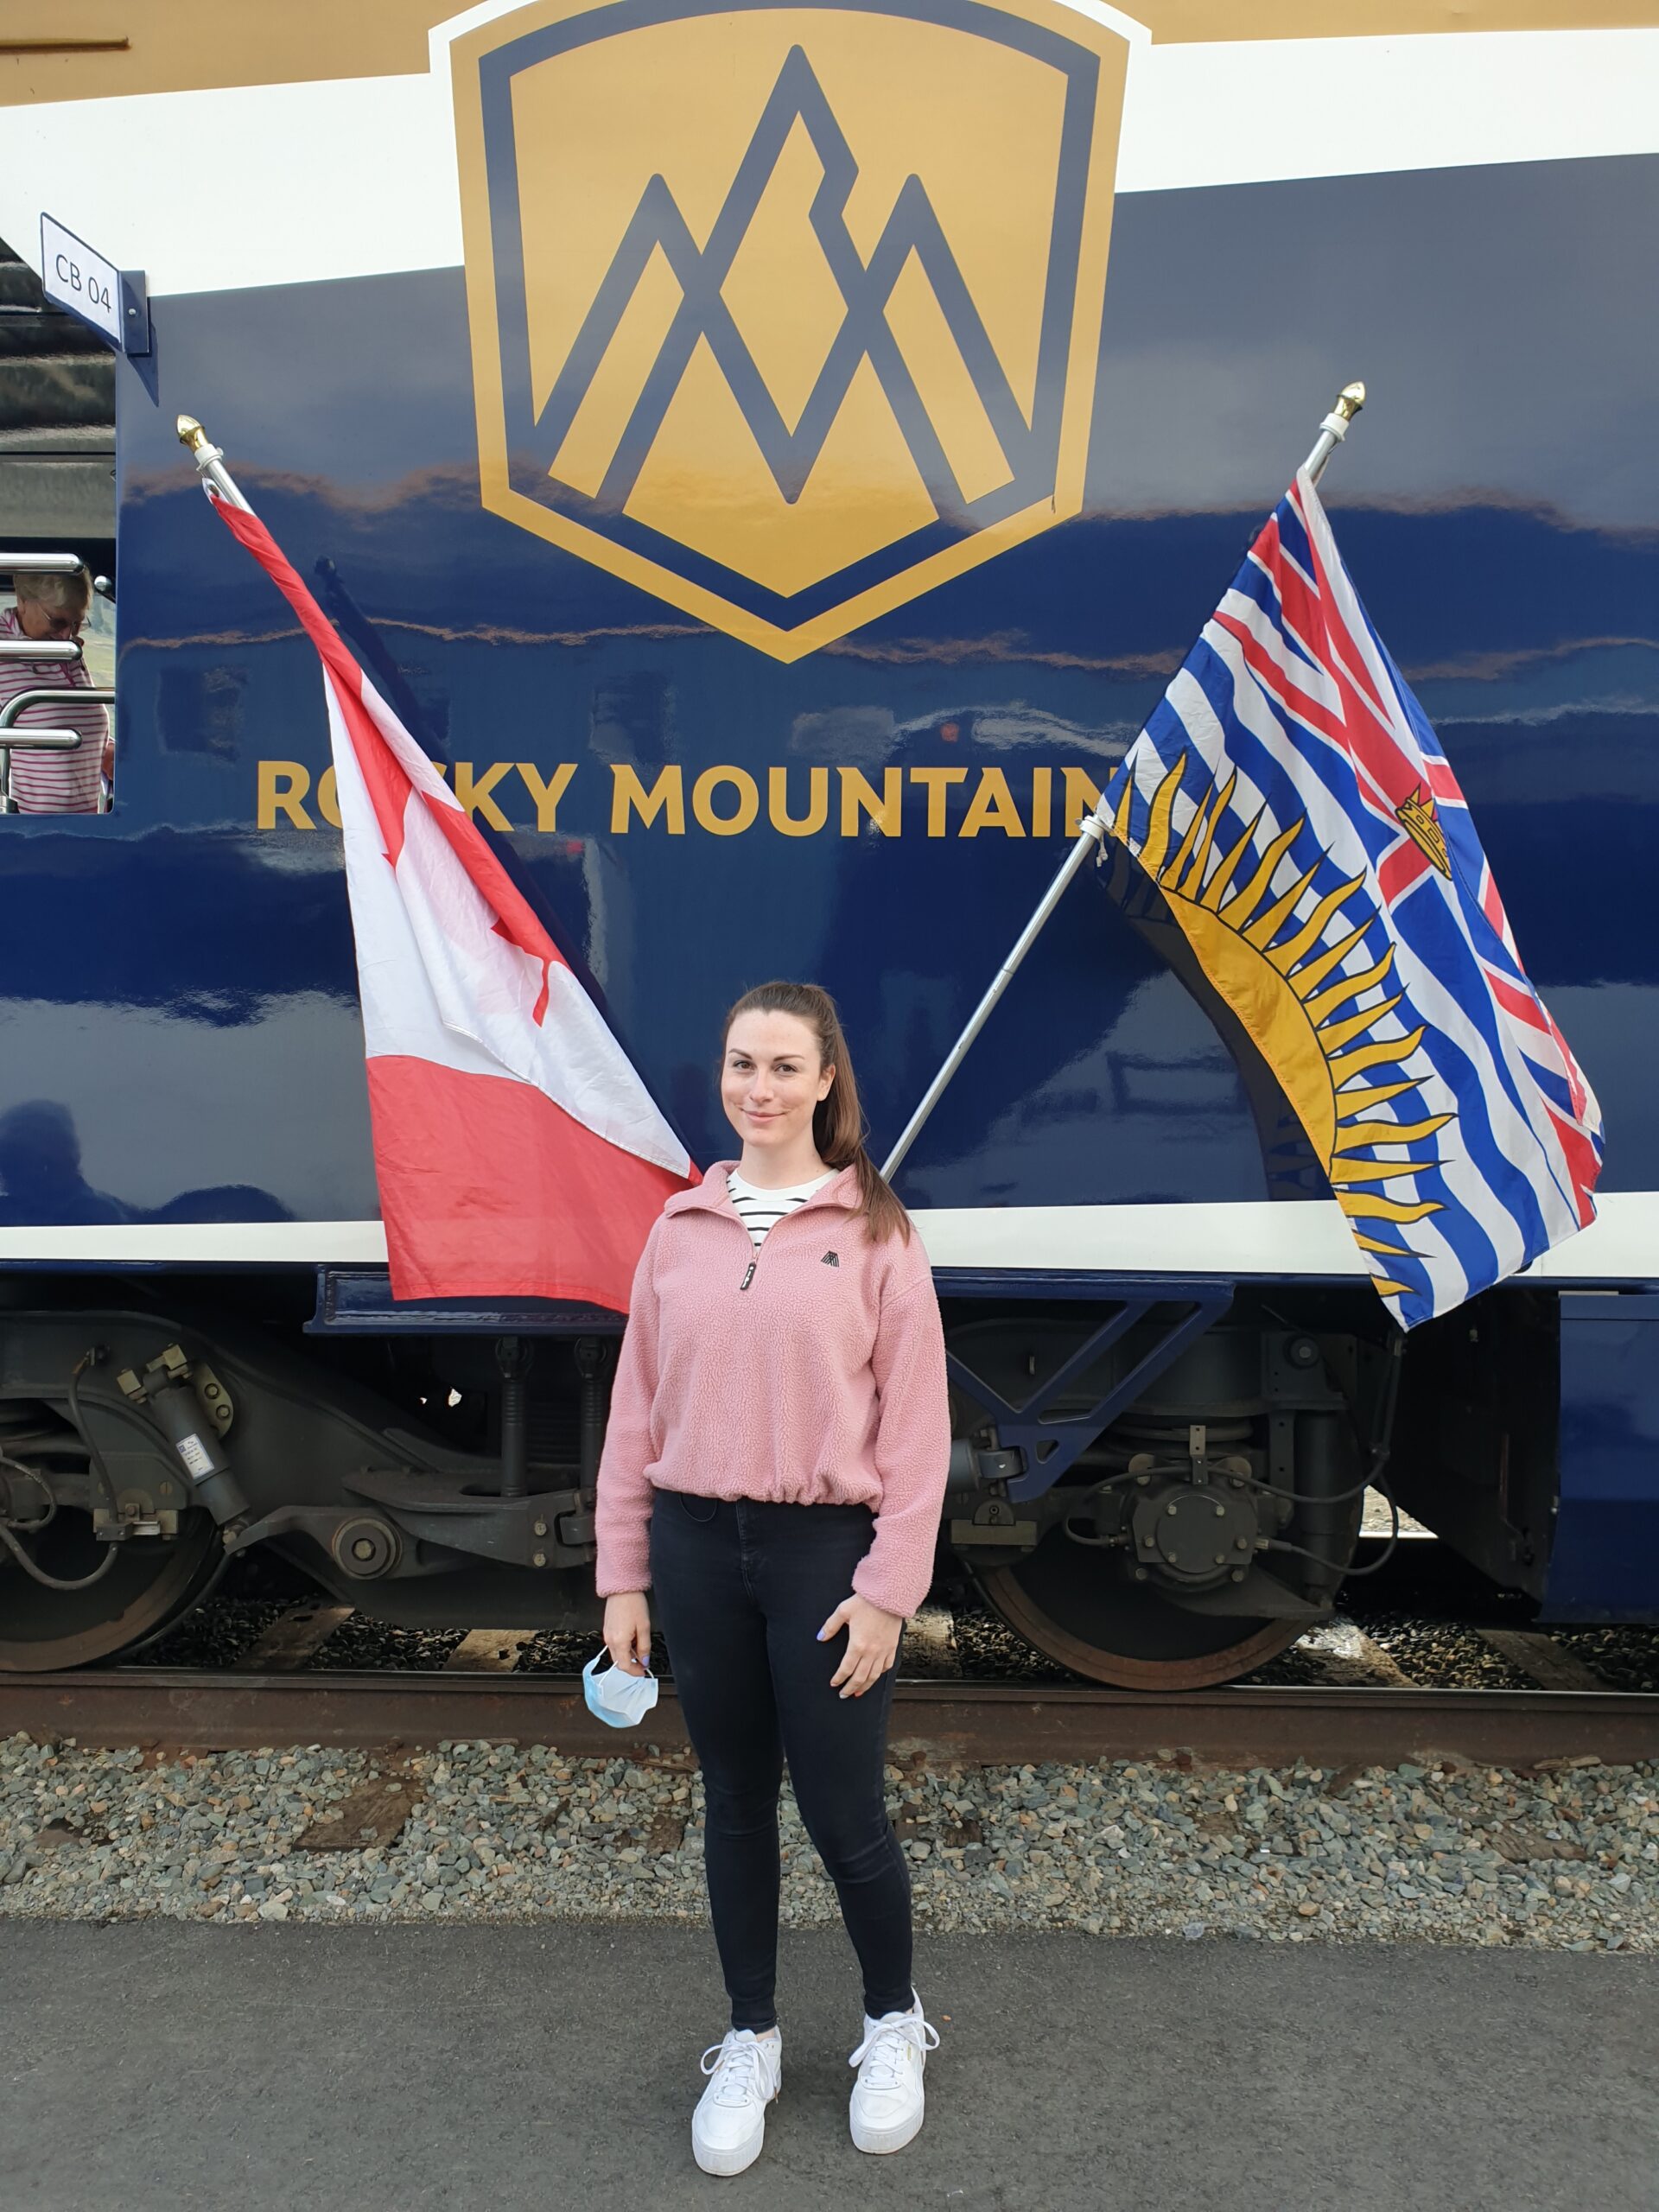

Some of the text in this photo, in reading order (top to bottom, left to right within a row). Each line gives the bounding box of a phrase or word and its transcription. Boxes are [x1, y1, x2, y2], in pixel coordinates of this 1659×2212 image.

[56, 254, 111, 314] CB 04
[257, 760, 579, 832] RKY
